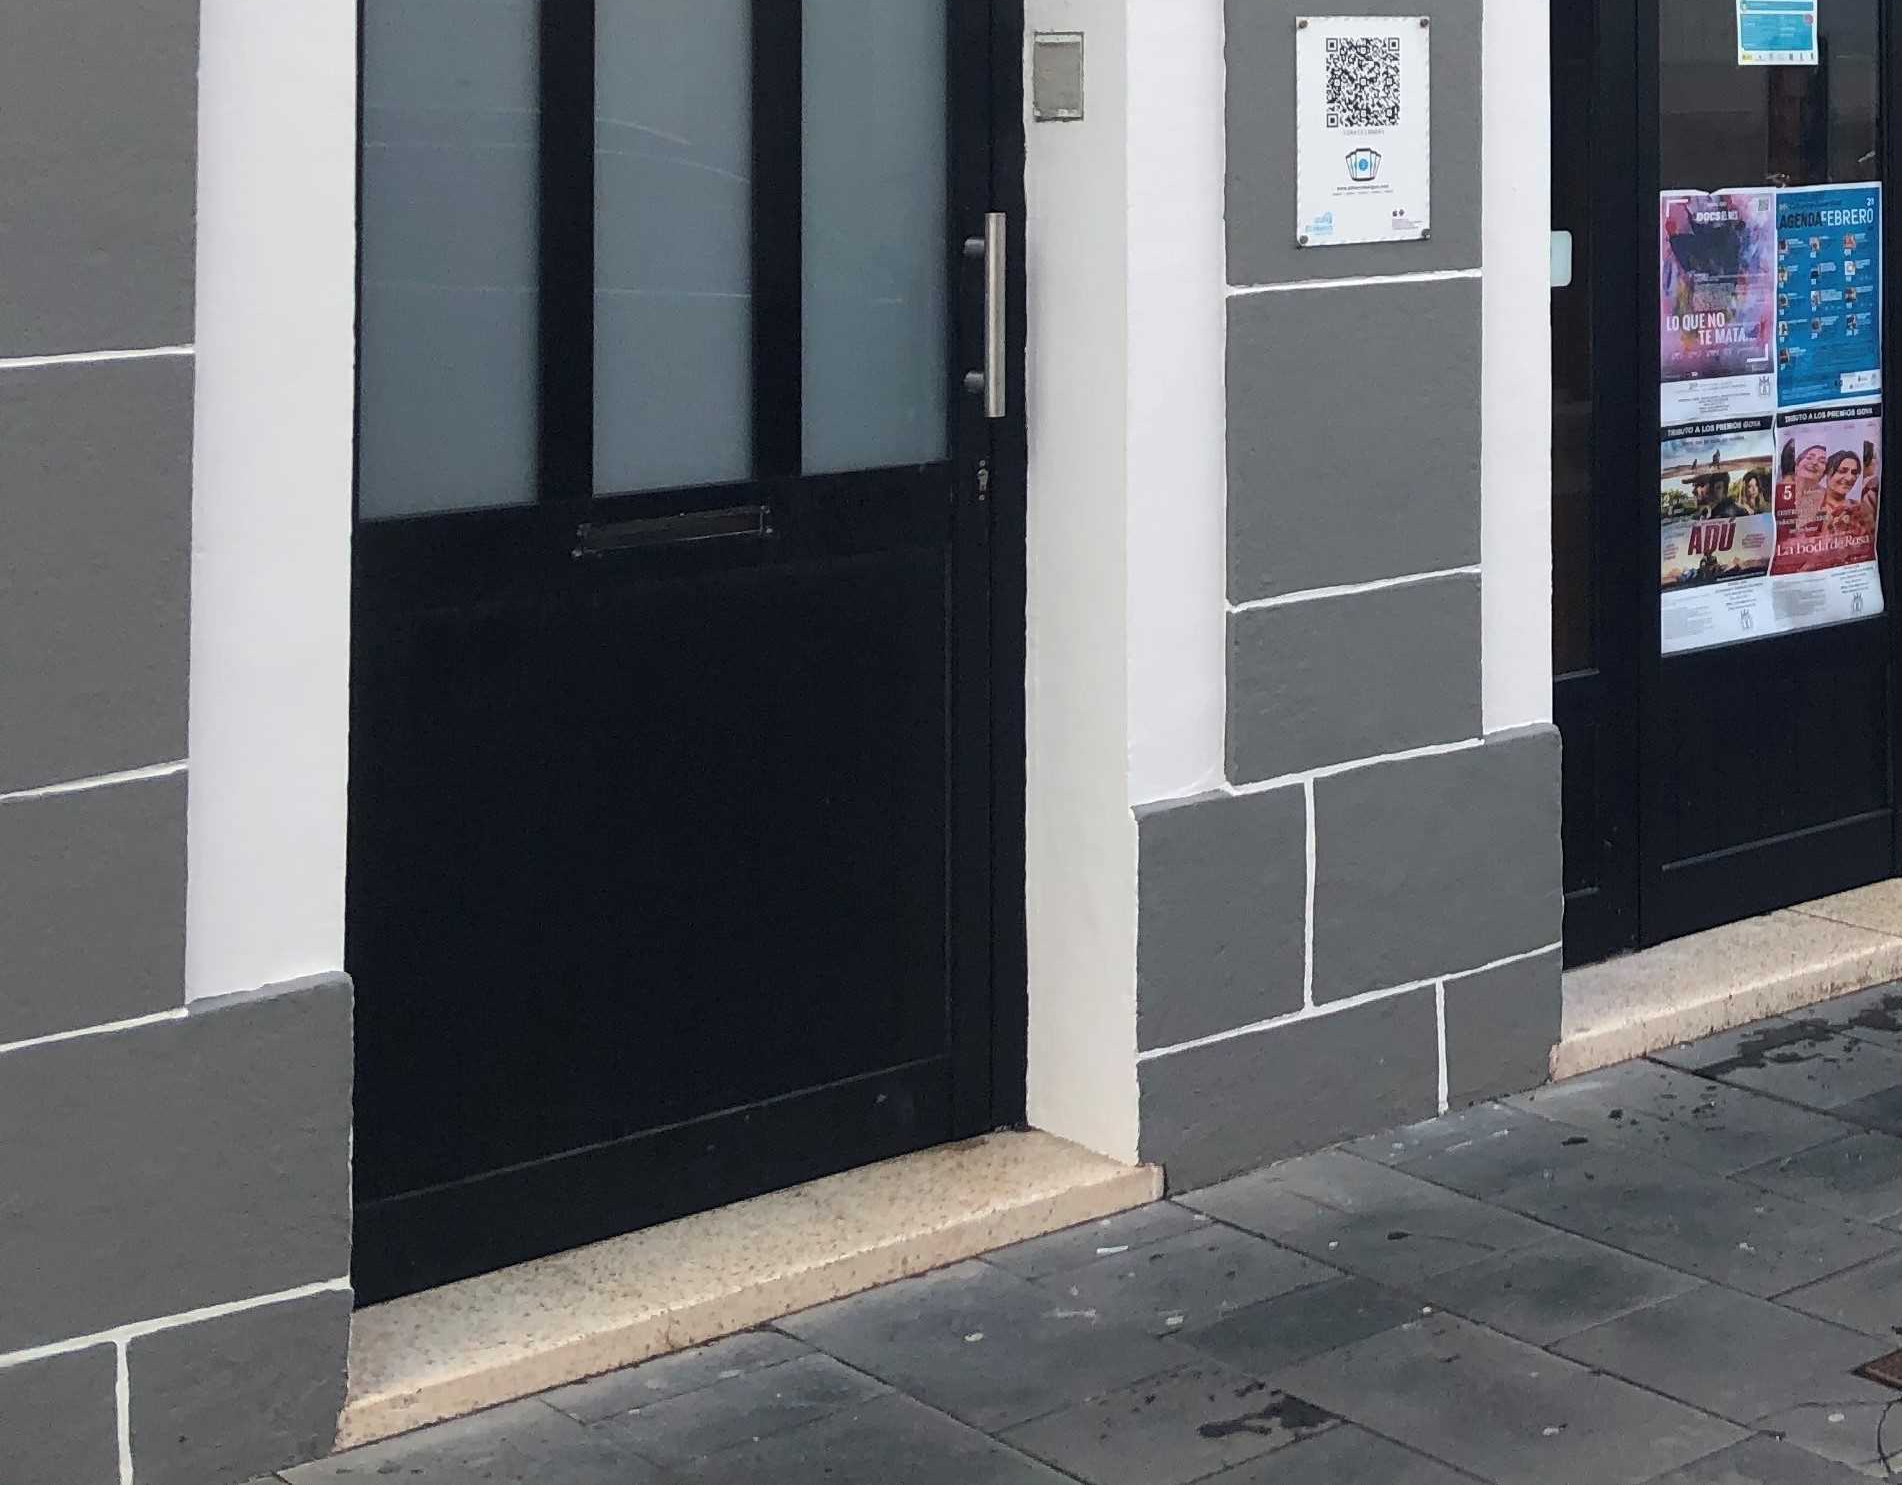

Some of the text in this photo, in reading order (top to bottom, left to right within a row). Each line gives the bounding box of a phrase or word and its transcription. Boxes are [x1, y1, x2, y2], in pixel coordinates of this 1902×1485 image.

[1779, 208, 1873, 228] AGENDA FEBRERO
[1666, 312, 1725, 331] LO QUE NO
[1698, 329, 1712, 345] TE
[1814, 412, 1826, 420] LOS
[1702, 424, 1715, 432] LOS
[1784, 485, 1792, 500] 5
[1688, 517, 1736, 555] ADÚ
[1777, 535, 1870, 556] La boda de Rosa
